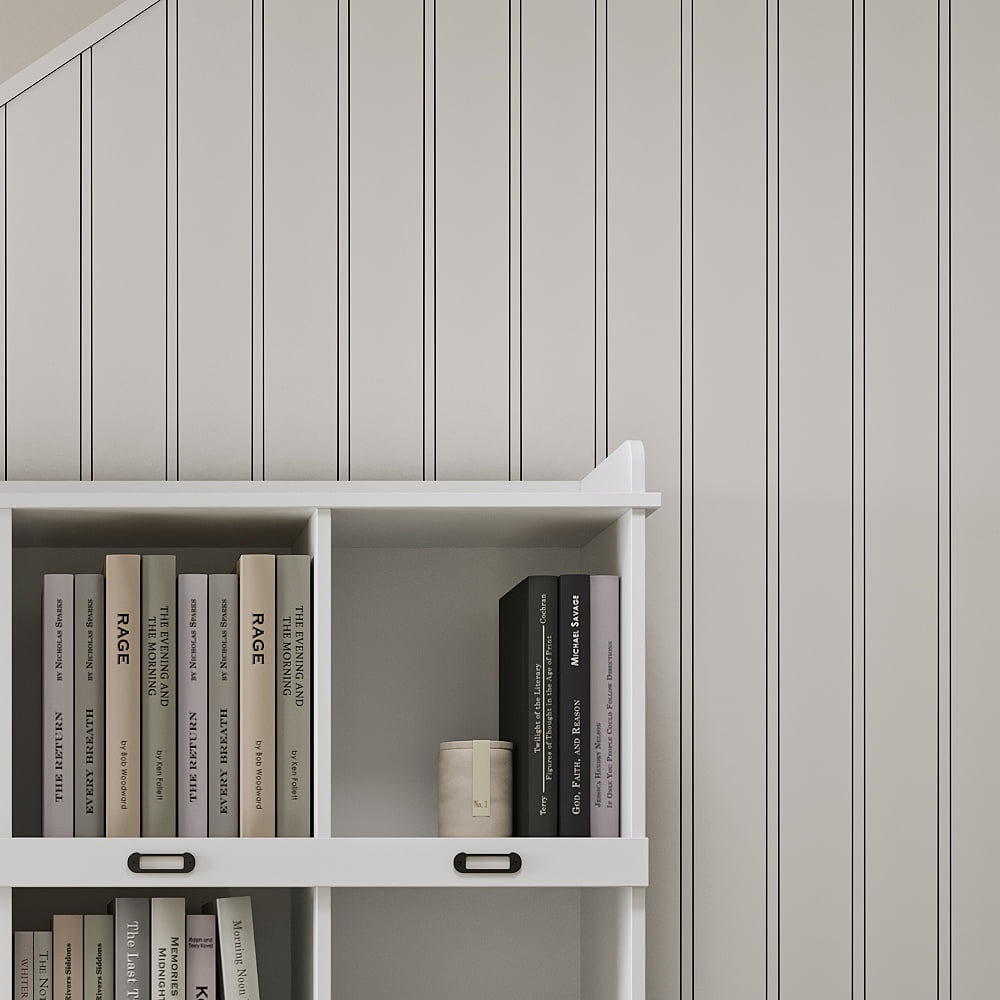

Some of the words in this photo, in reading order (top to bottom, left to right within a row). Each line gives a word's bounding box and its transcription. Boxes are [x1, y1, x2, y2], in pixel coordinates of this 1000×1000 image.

[571, 595, 579, 627] SAVAGE
[117, 613, 129, 665] RAGE
[252, 613, 264, 665] RAGE
[282, 617, 291, 638] THE
[571, 630, 579, 666] MICHAEL
[282, 642, 291, 696] MORNING
[535, 711, 541, 722] of
[572, 700, 581, 734] REASON
[120, 741, 127, 750] by
[572, 761, 581, 788] FAITH,
[572, 793, 581, 814] GOD,
